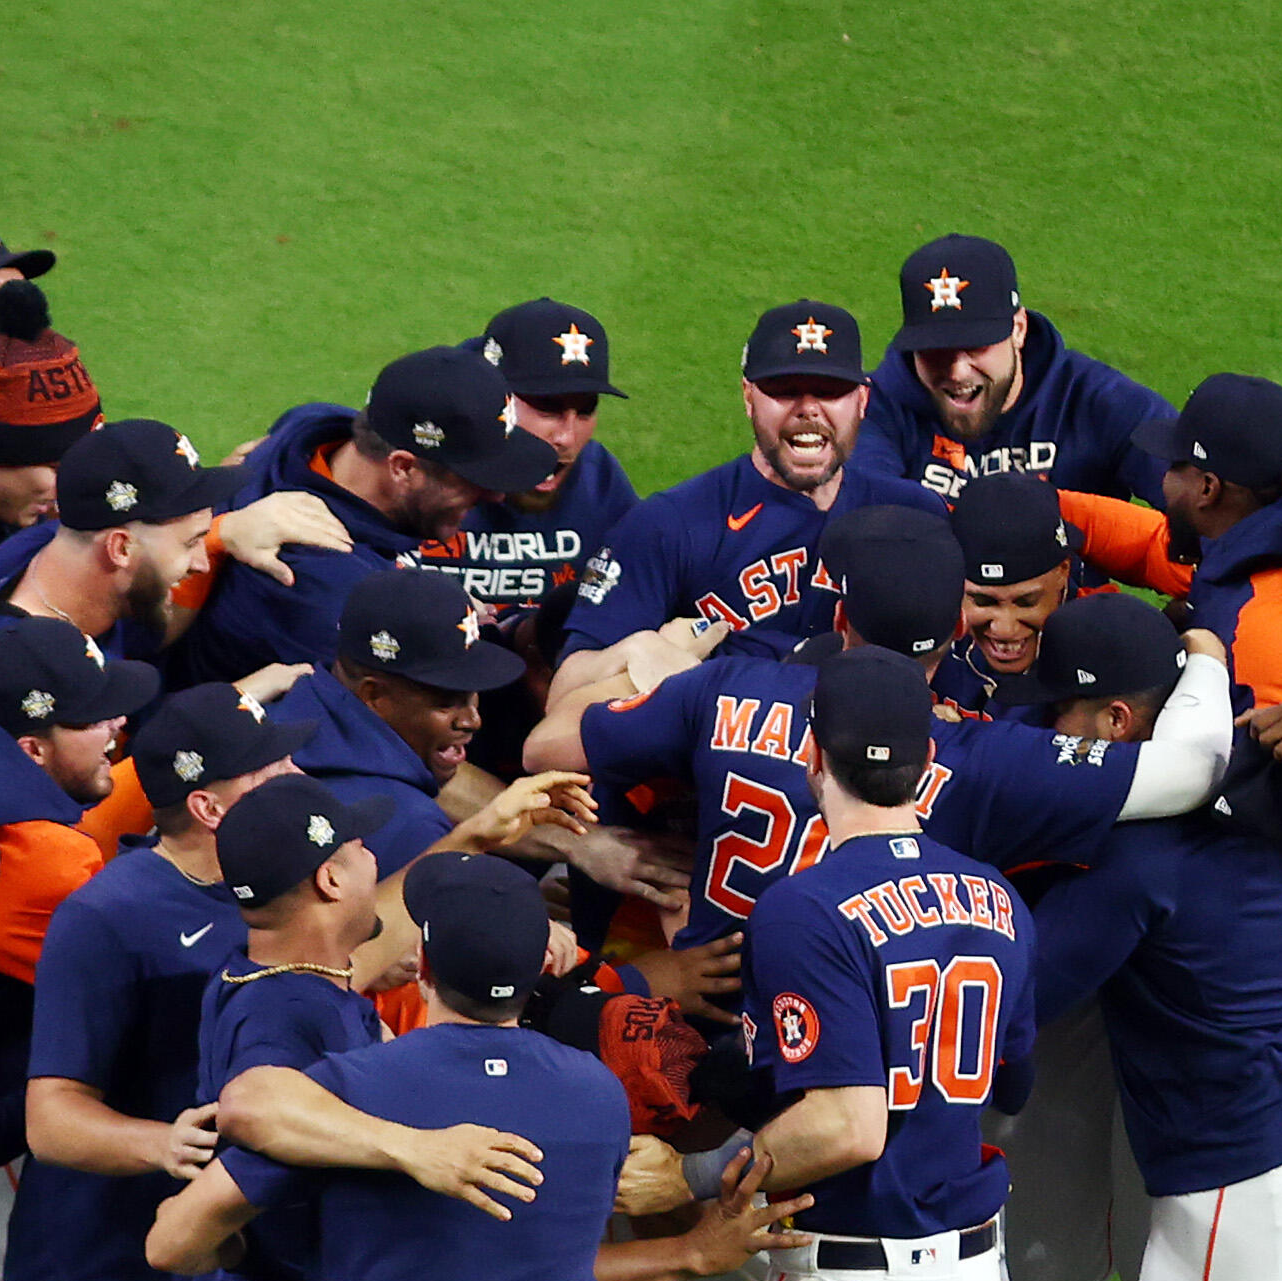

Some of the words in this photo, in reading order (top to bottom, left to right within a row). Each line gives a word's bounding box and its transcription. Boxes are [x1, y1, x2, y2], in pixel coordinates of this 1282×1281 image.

[466, 529, 582, 563] WORLD
[421, 564, 547, 597] RIES
[837, 873, 1016, 947] TUCKER
[885, 955, 1003, 1111] 30
